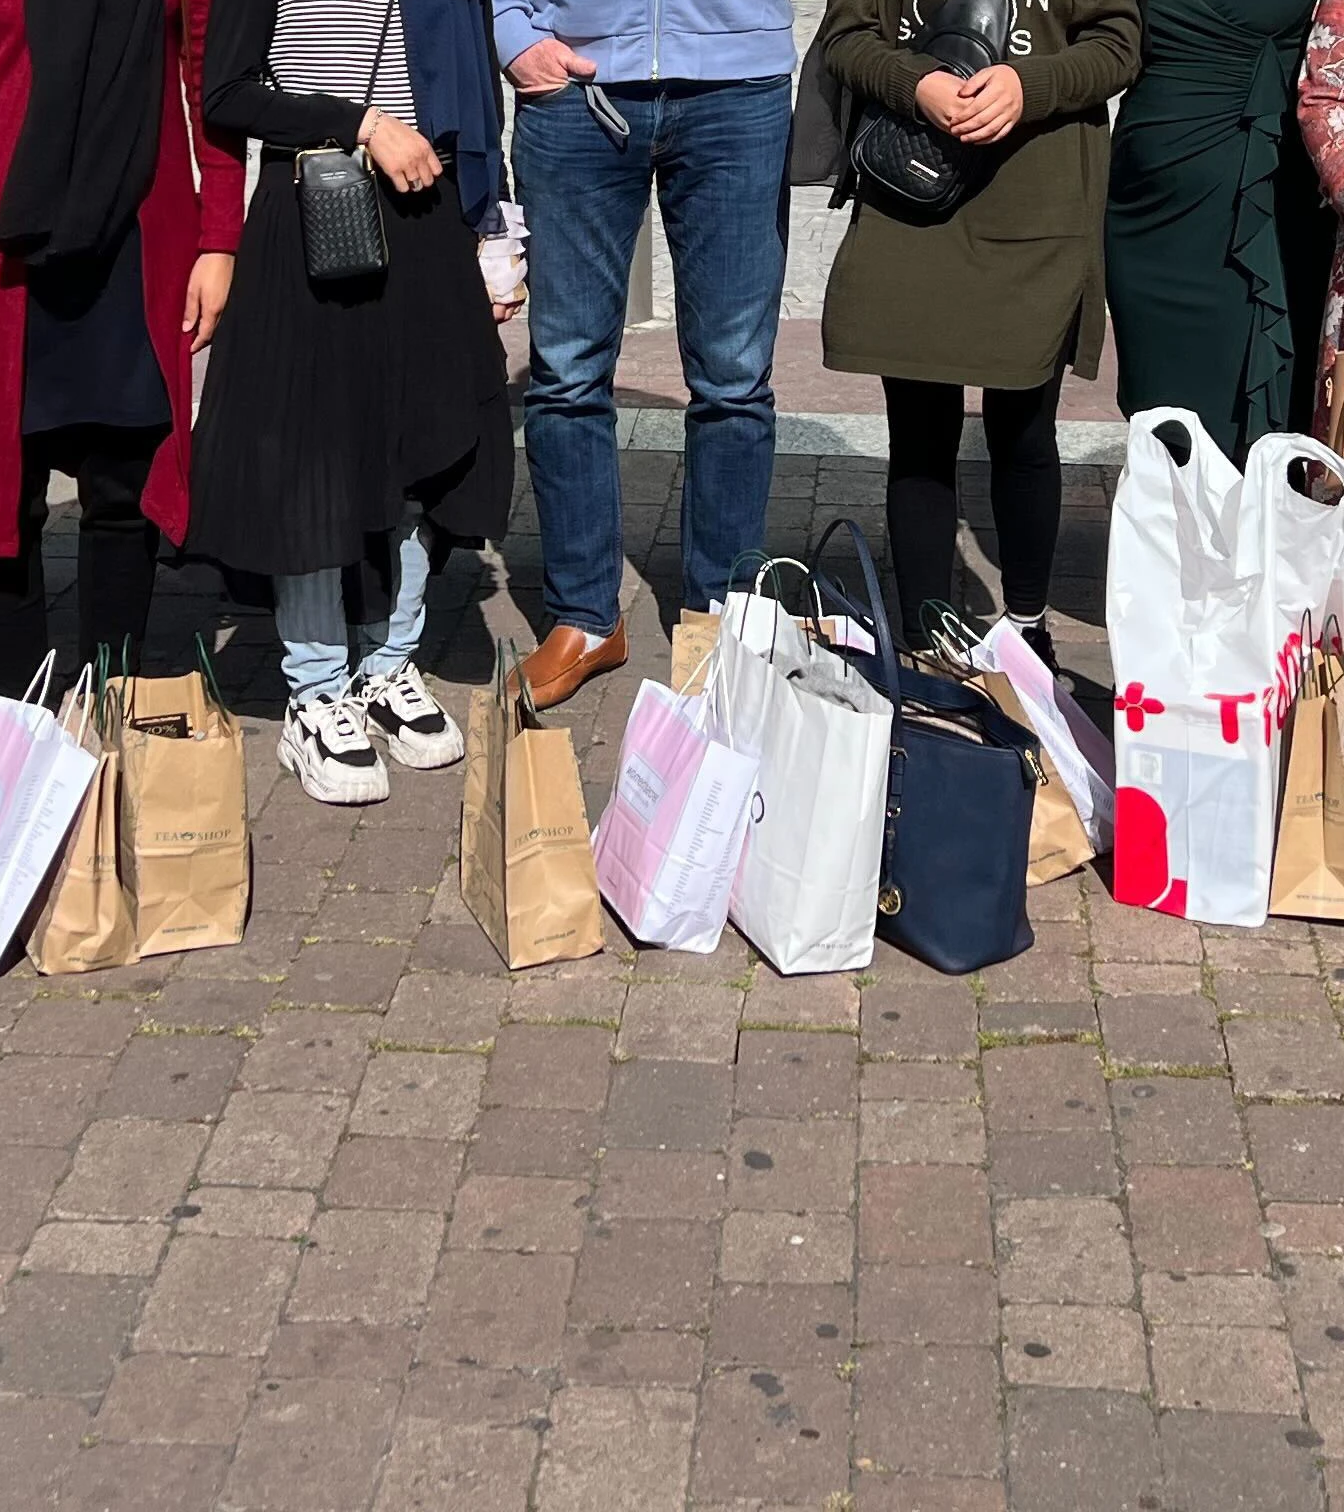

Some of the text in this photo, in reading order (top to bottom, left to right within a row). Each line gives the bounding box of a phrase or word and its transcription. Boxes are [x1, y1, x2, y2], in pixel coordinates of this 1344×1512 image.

[154, 828, 232, 841] TEA SHOP
[542, 826, 574, 838] SHOP
